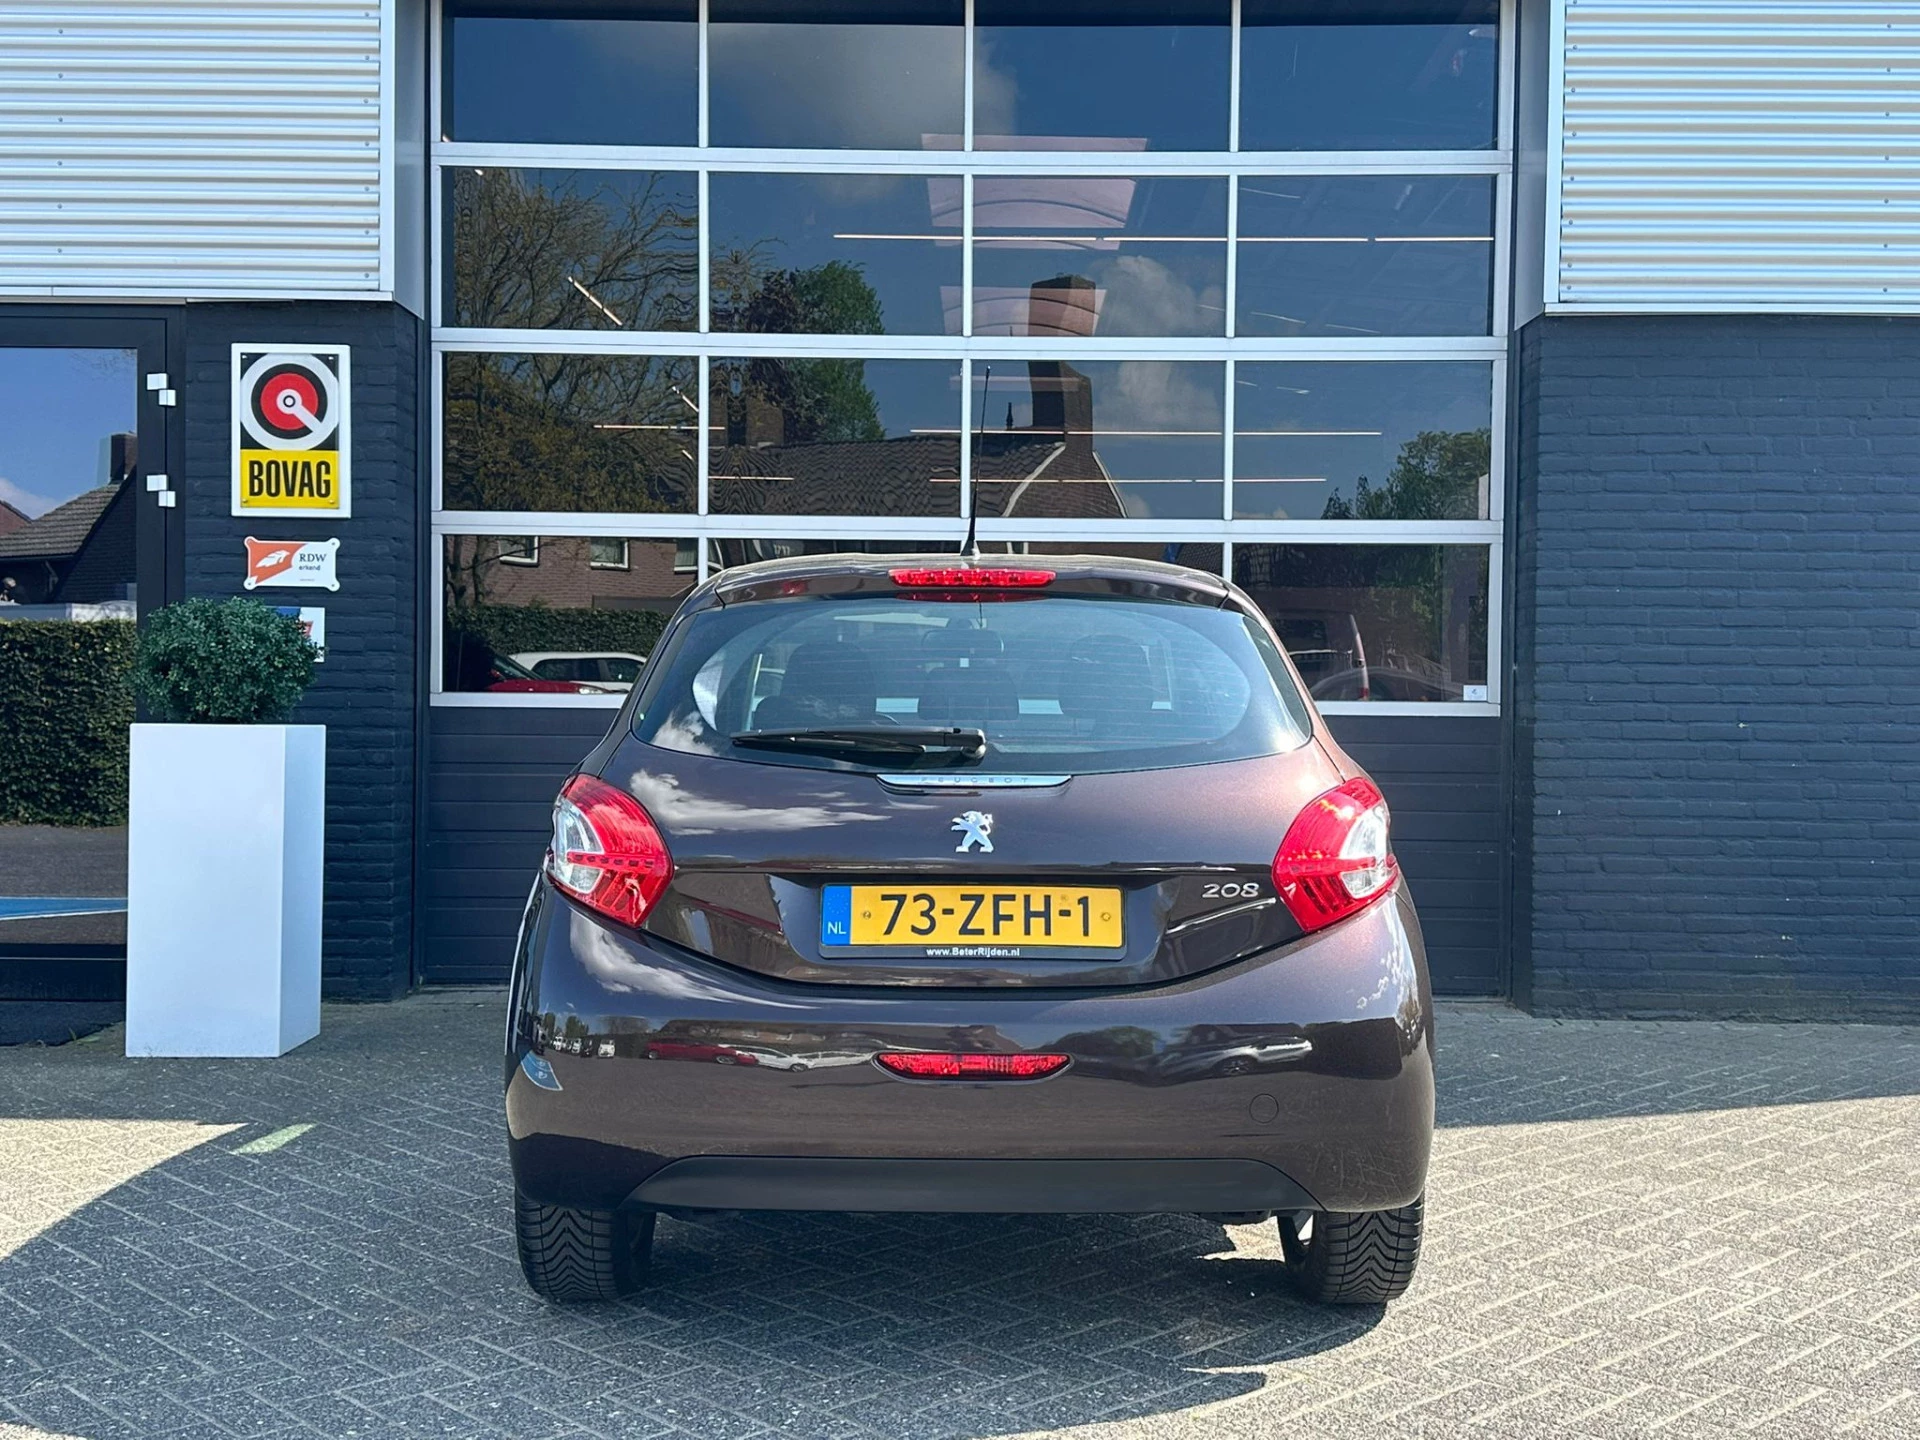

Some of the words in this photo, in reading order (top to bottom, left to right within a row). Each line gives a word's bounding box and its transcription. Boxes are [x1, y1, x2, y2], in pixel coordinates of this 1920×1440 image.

[248, 459, 332, 498] BOVAG
[299, 553, 327, 562] RDW
[1202, 883, 1260, 898] 208
[880, 893, 1090, 937] 73-ZFH-1
[827, 921, 847, 935] NL
[926, 947, 1020, 958] www.BeterRijden.nl
